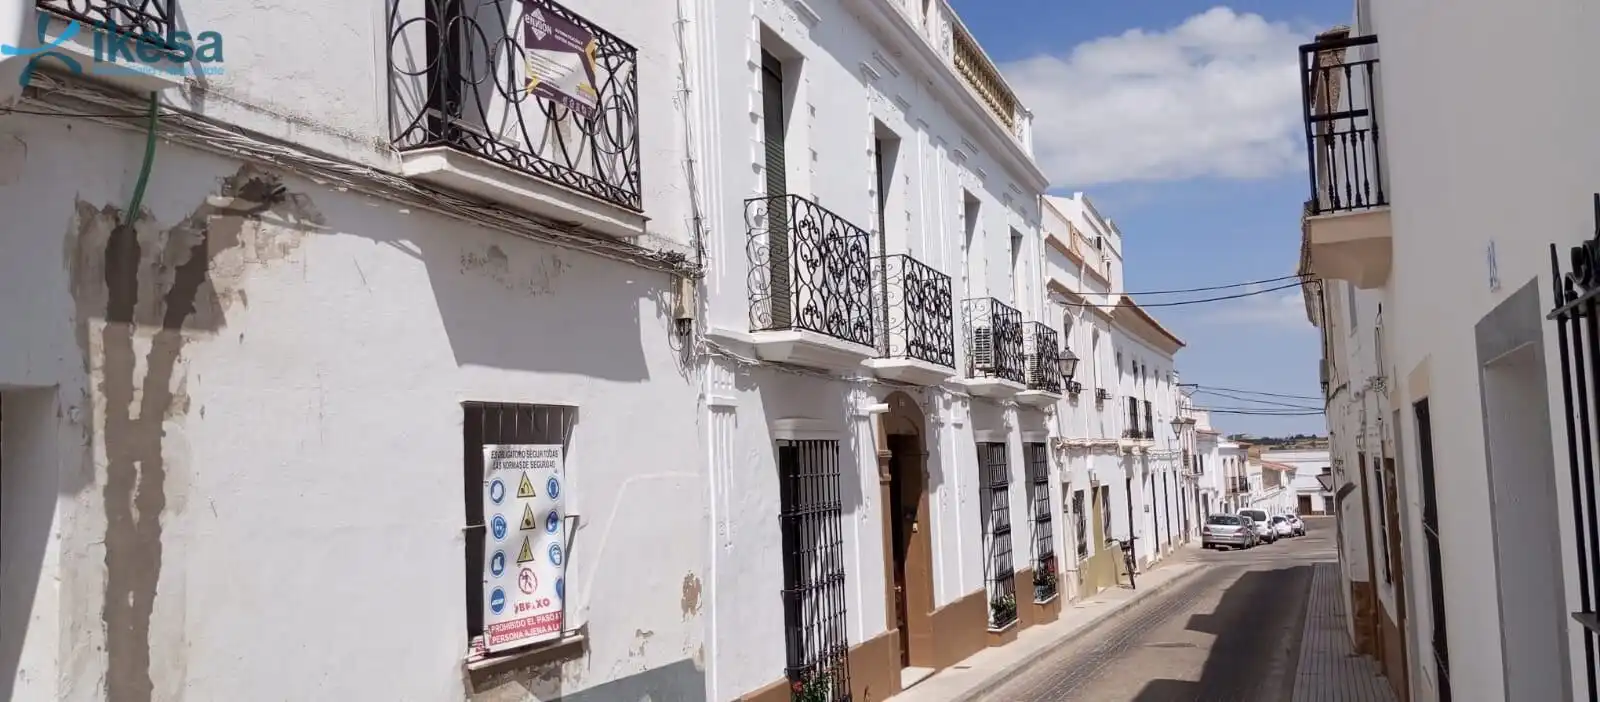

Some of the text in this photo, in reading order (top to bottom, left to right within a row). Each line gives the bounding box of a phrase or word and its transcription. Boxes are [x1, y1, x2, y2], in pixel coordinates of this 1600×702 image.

[543, 449, 559, 458] TODAS
[503, 460, 522, 469] NORMAS
[522, 460, 530, 469] DE
[491, 619, 526, 632] PROHIBIDO
[527, 617, 536, 626] EL
[536, 614, 555, 624] PASO
[491, 631, 524, 644] PERSONA
[524, 626, 547, 636] AJENA
